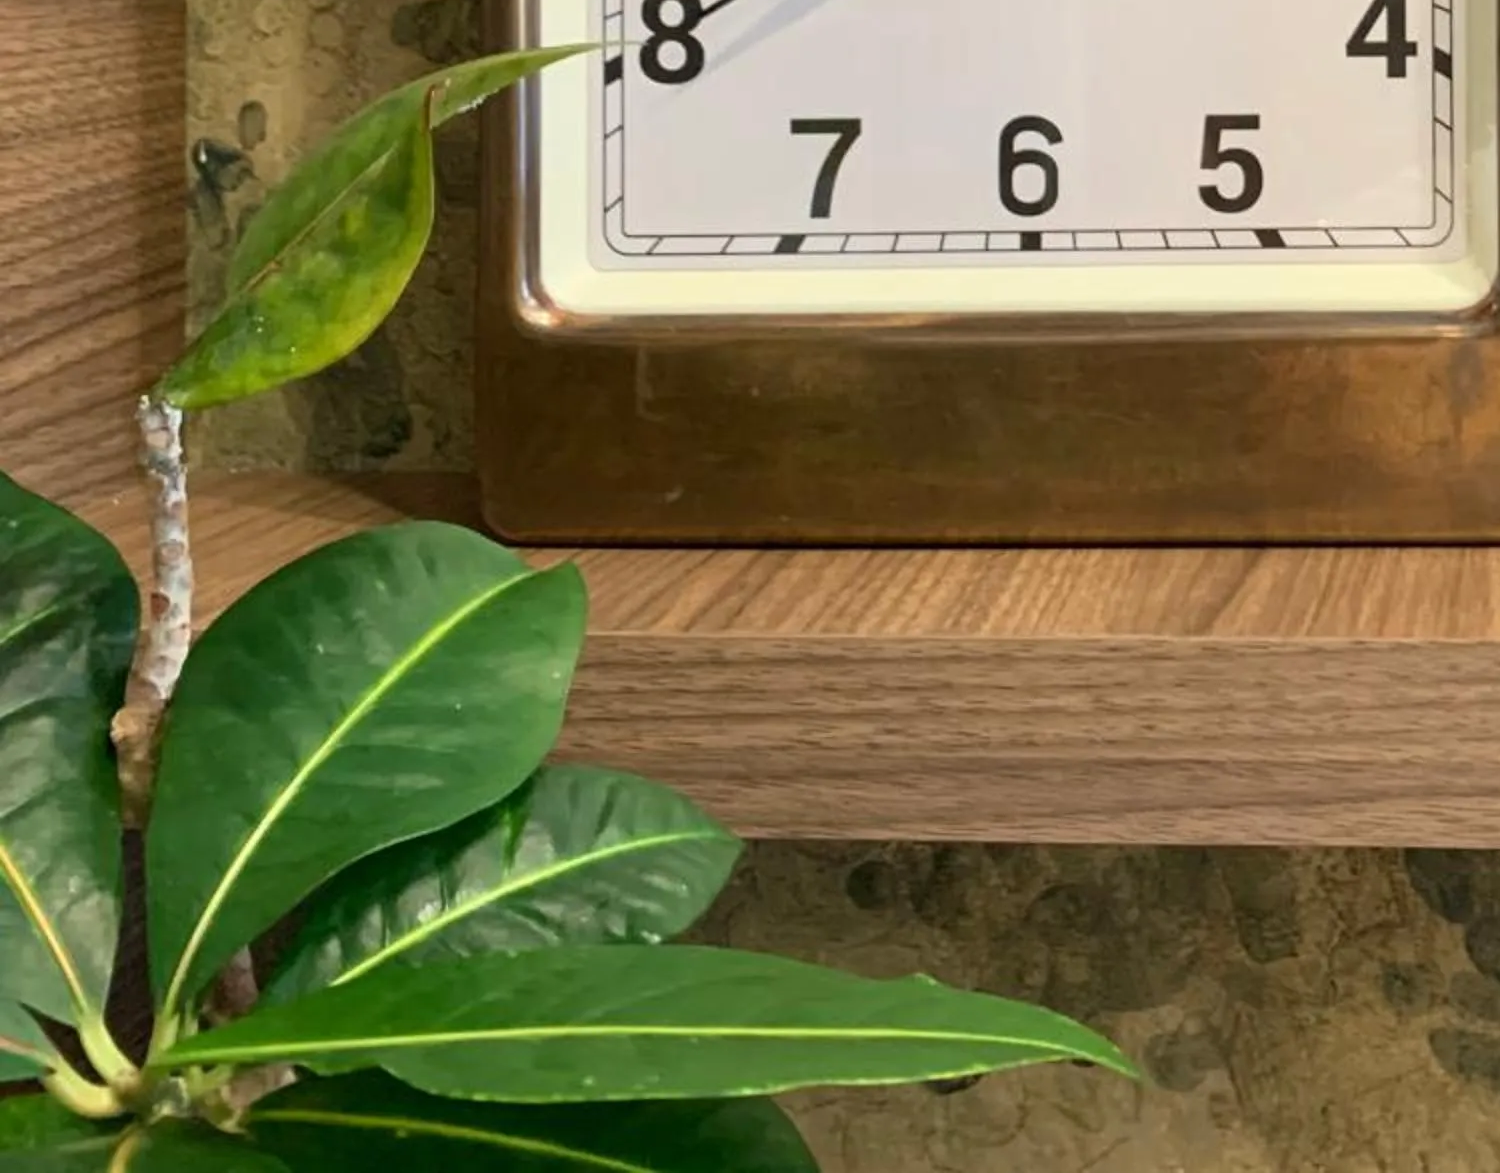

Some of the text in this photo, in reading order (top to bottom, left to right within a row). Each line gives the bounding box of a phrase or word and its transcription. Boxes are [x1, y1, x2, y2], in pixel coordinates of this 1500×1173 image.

[789, 118, 863, 220] 7
[998, 116, 1065, 218] 6
[1197, 114, 1266, 215] 5
